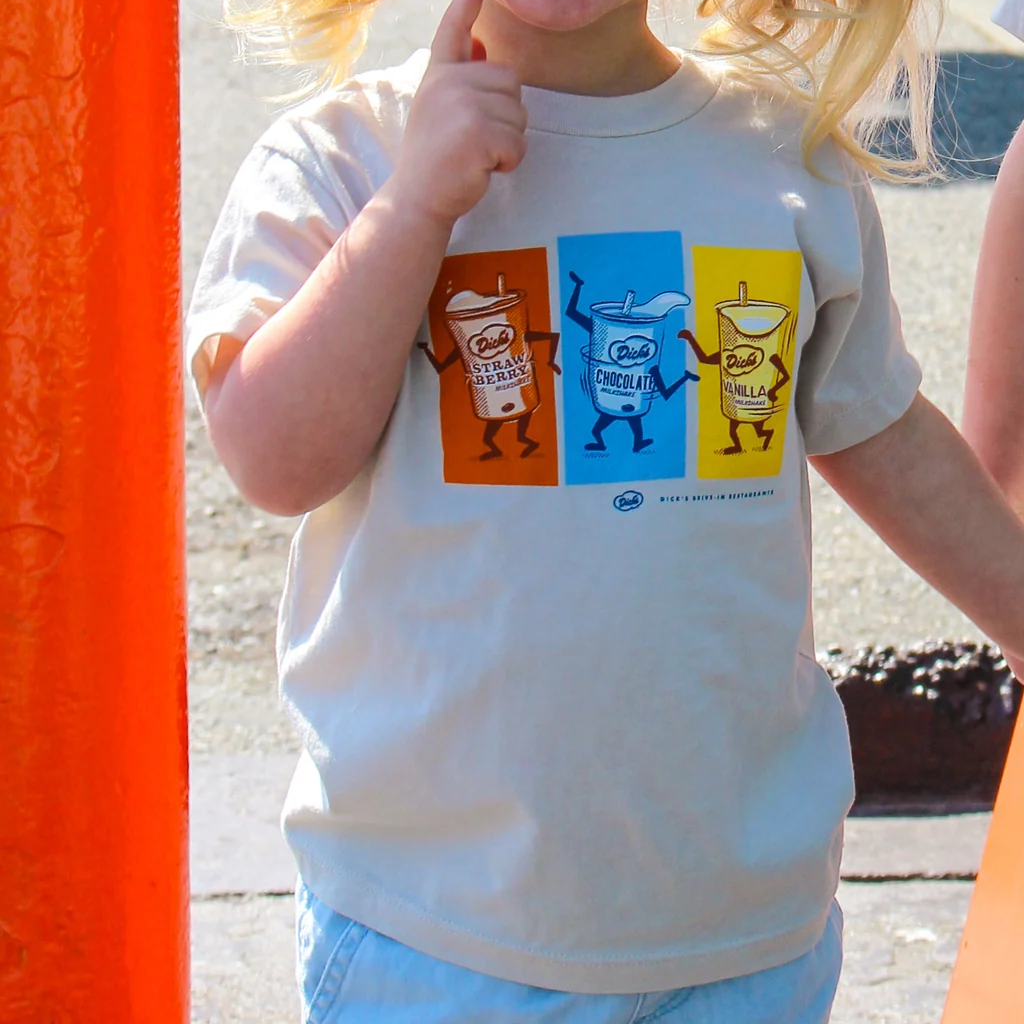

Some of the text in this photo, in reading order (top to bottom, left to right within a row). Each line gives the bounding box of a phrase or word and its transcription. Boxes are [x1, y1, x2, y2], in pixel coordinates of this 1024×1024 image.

[472, 352, 526, 374] STRAW
[473, 365, 527, 385] BERRY
[723, 379, 767, 398] VANILLA
